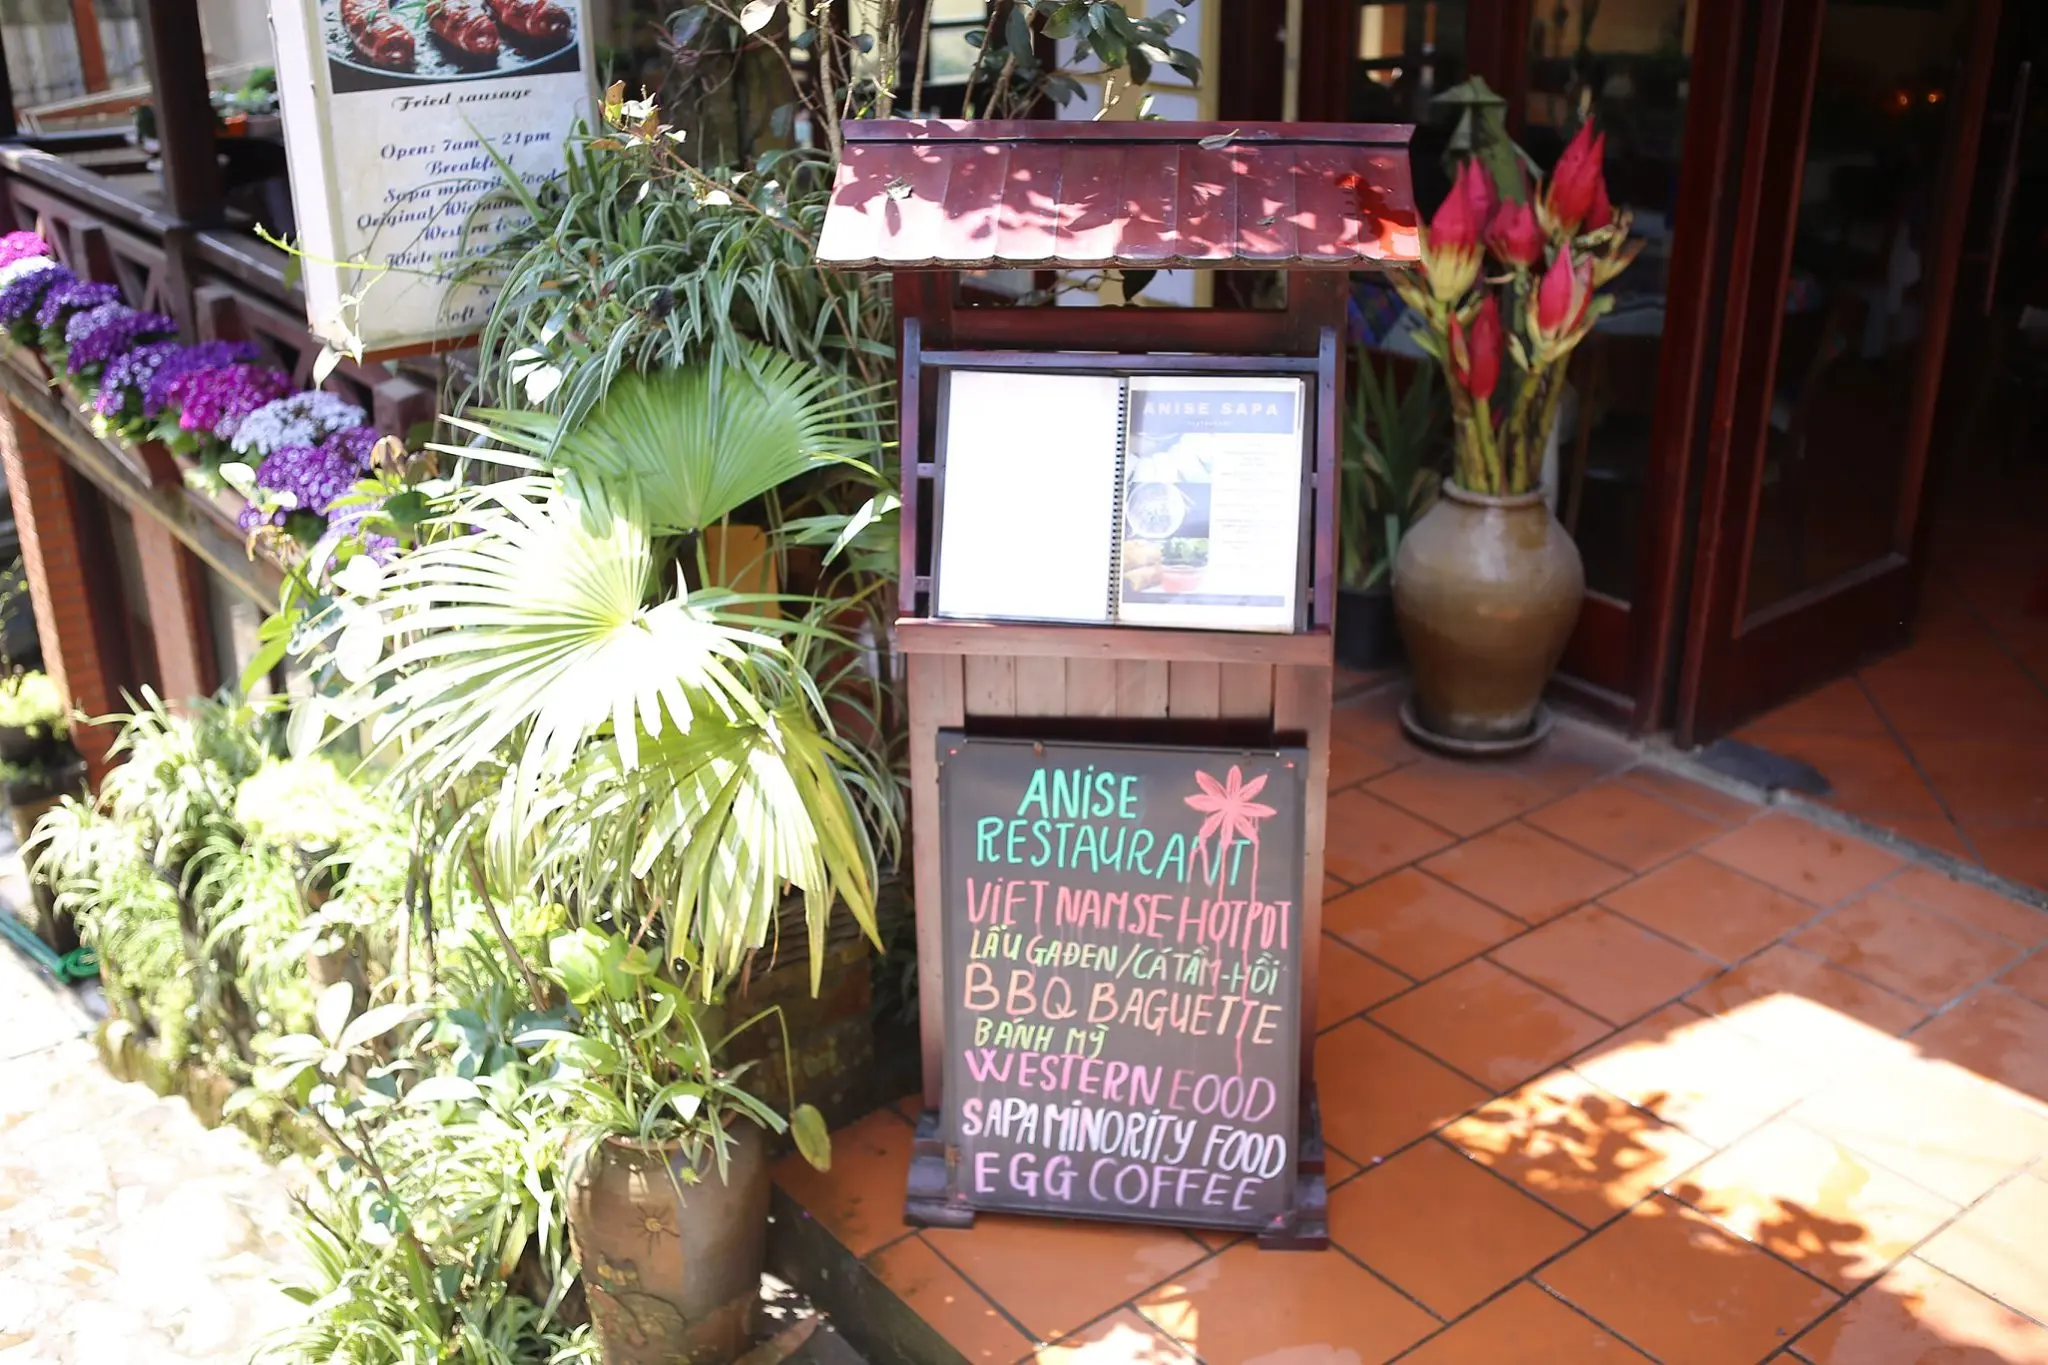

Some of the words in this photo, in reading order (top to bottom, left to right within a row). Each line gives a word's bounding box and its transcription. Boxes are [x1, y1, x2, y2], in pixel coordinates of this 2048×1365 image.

[391, 91, 452, 112] Fried
[457, 87, 532, 104] sausage
[380, 142, 436, 161] Open:
[442, 137, 480, 152] 7am
[501, 130, 552, 147] 21pm
[425, 154, 515, 176] Breakfat
[423, 222, 490, 241] Westrn
[1143, 401, 1210, 417] ANISE
[1220, 401, 1279, 418] SAPA
[976, 816, 1252, 886] RESTAURANT
[1177, 895, 1292, 952] HOTPOT
[963, 961, 1078, 1021] BBQ
[1087, 981, 1283, 1045] BAGUETTE
[964, 1048, 1164, 1107] WESTERN
[961, 1097, 1039, 1145] SAPA
[1202, 1123, 1288, 1180] FOOD
[974, 1151, 1079, 1201] EGG
[1088, 1157, 1264, 1212] COFFEE
